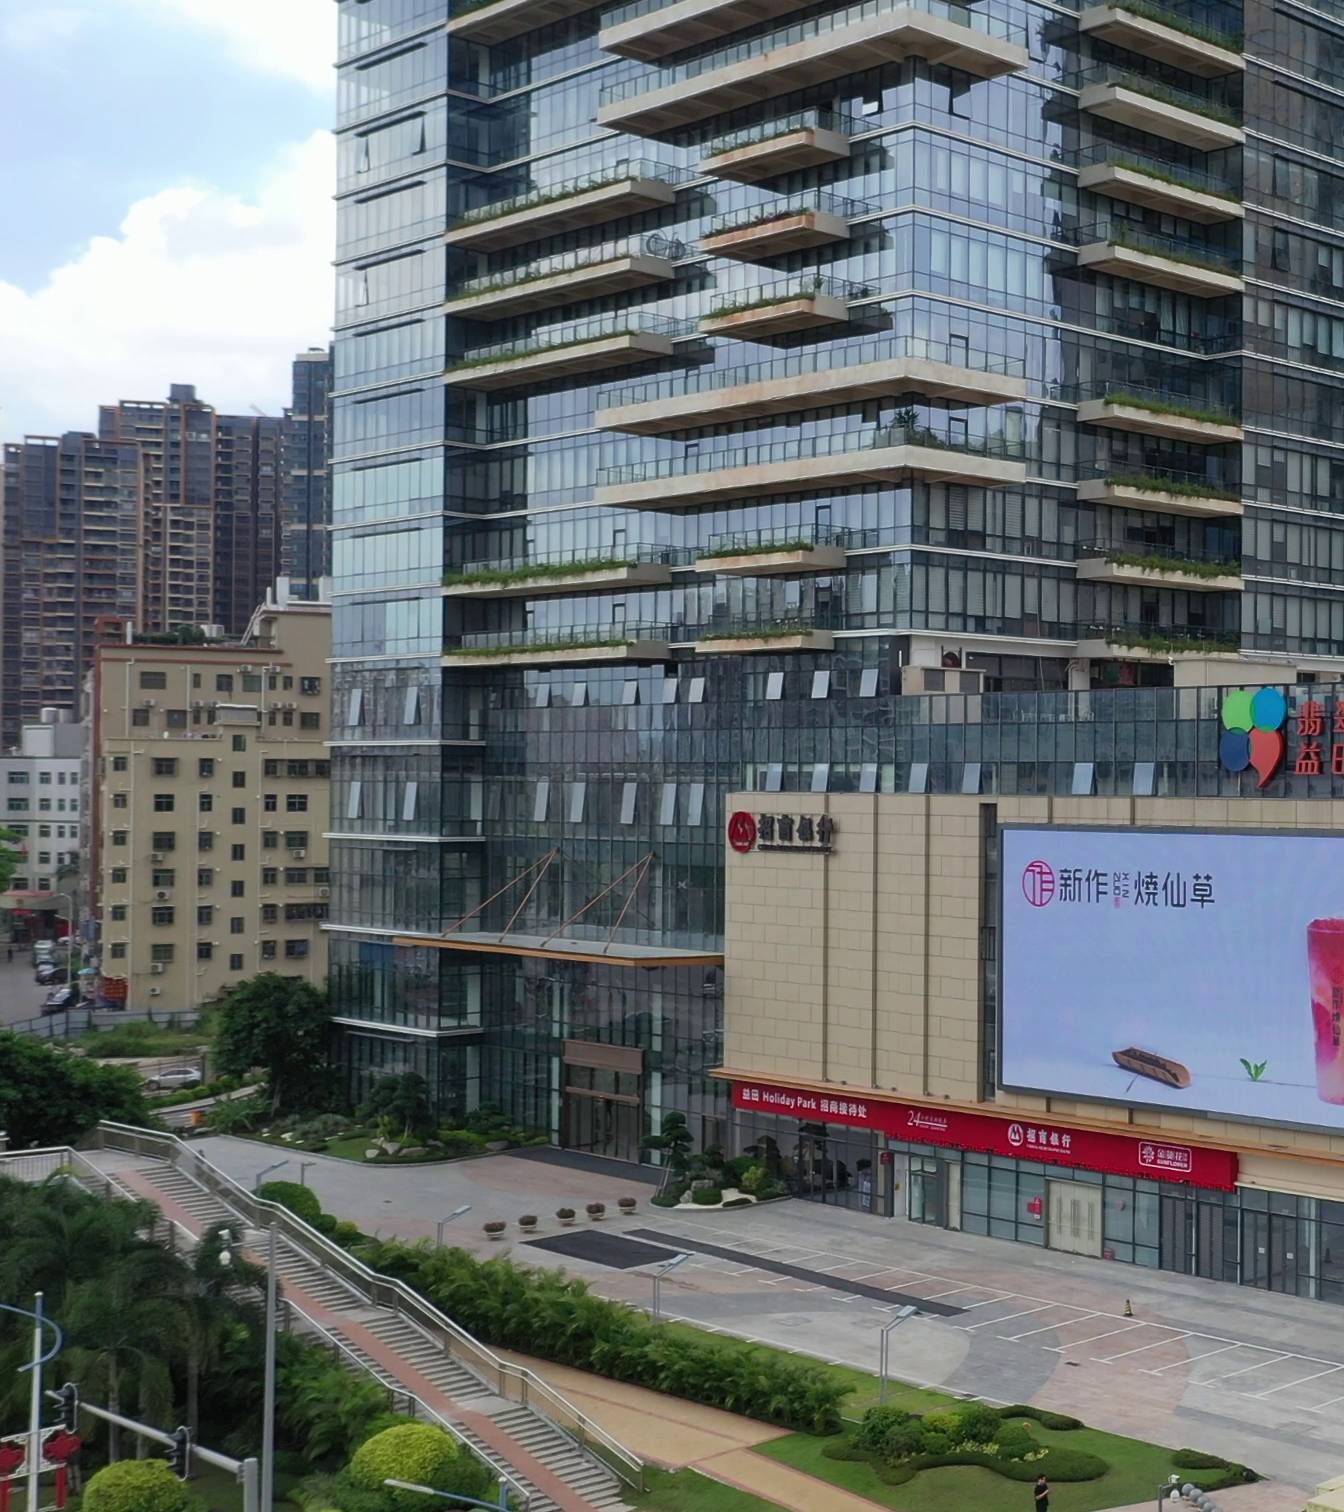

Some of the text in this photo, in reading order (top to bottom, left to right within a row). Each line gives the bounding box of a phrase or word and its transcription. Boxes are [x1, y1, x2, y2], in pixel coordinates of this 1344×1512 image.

[1059, 867, 1108, 904] 新作
[762, 1091, 795, 1109] Holiday
[797, 1096, 817, 1110] Park
